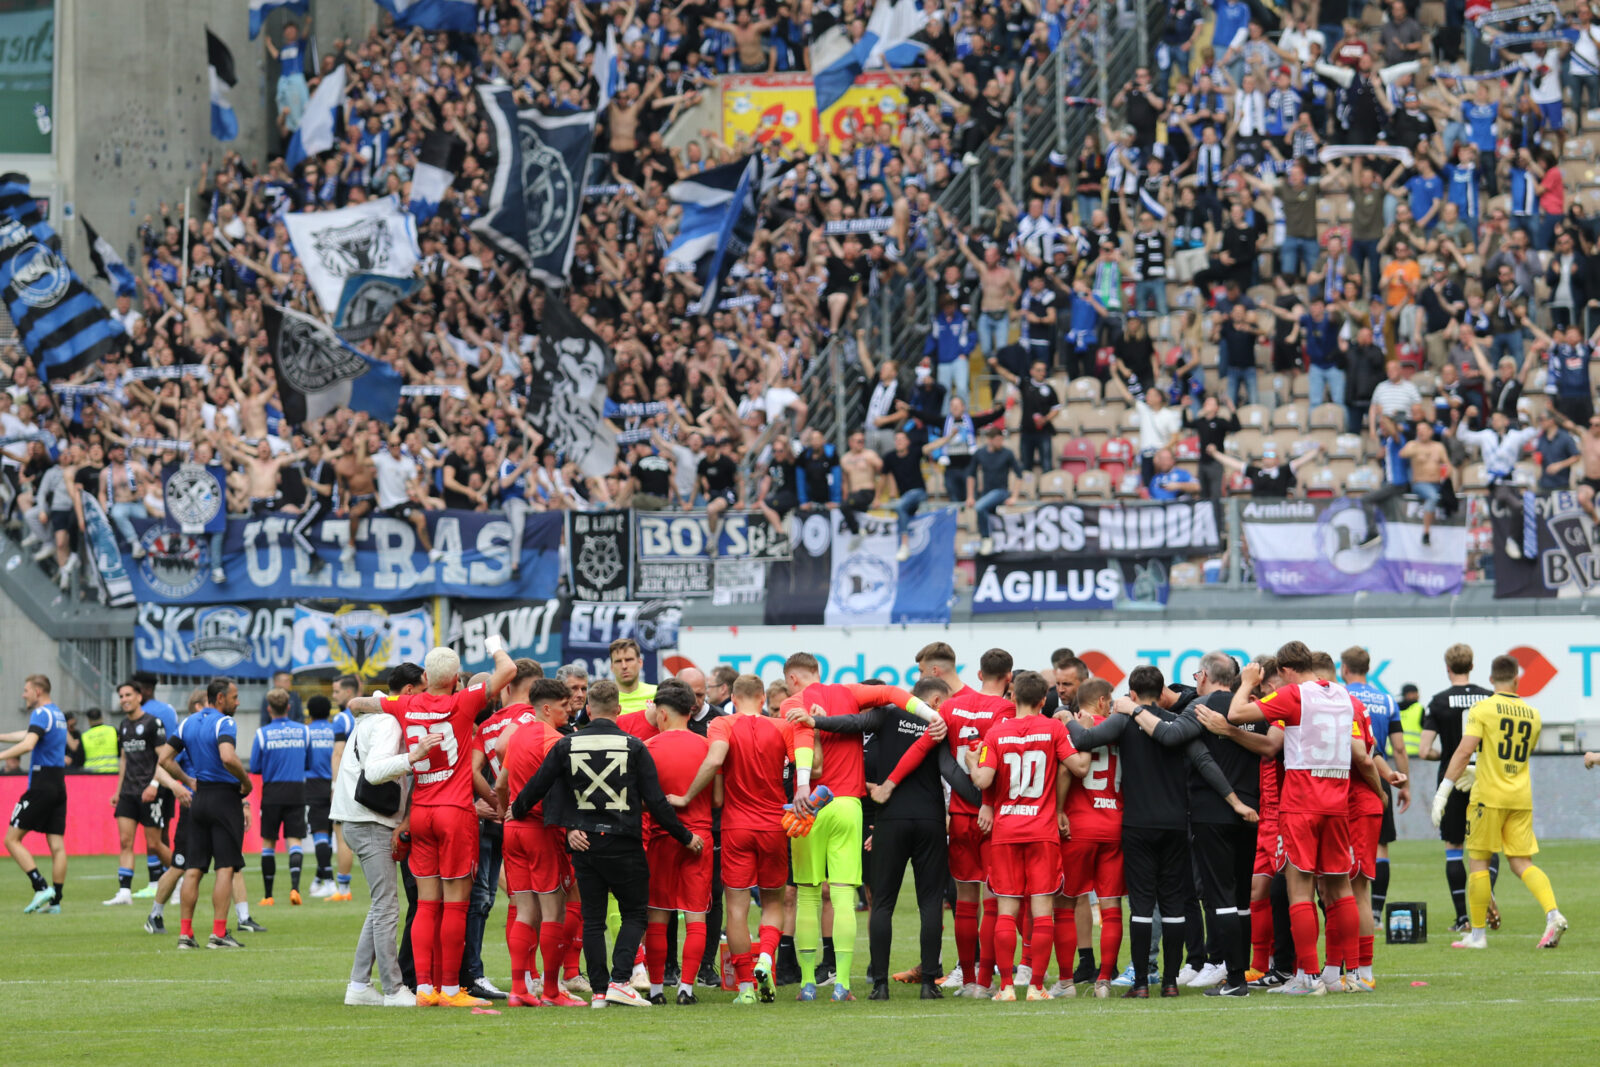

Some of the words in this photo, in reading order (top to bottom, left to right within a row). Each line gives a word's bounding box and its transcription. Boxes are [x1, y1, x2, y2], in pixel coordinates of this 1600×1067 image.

[1243, 501, 1315, 519] Arminia
[1405, 501, 1447, 520] Fas
[243, 516, 514, 590] ULTRAS
[973, 565, 1121, 603] ÁGILUS
[137, 602, 195, 663] SK
[1496, 703, 1534, 719] BIELEFELD
[266, 739, 305, 750] macron
[1498, 717, 1532, 763] 33
[1003, 750, 1047, 800] 10
[1000, 805, 1039, 816] KEMENT
[1094, 797, 1118, 809] ZUCK
